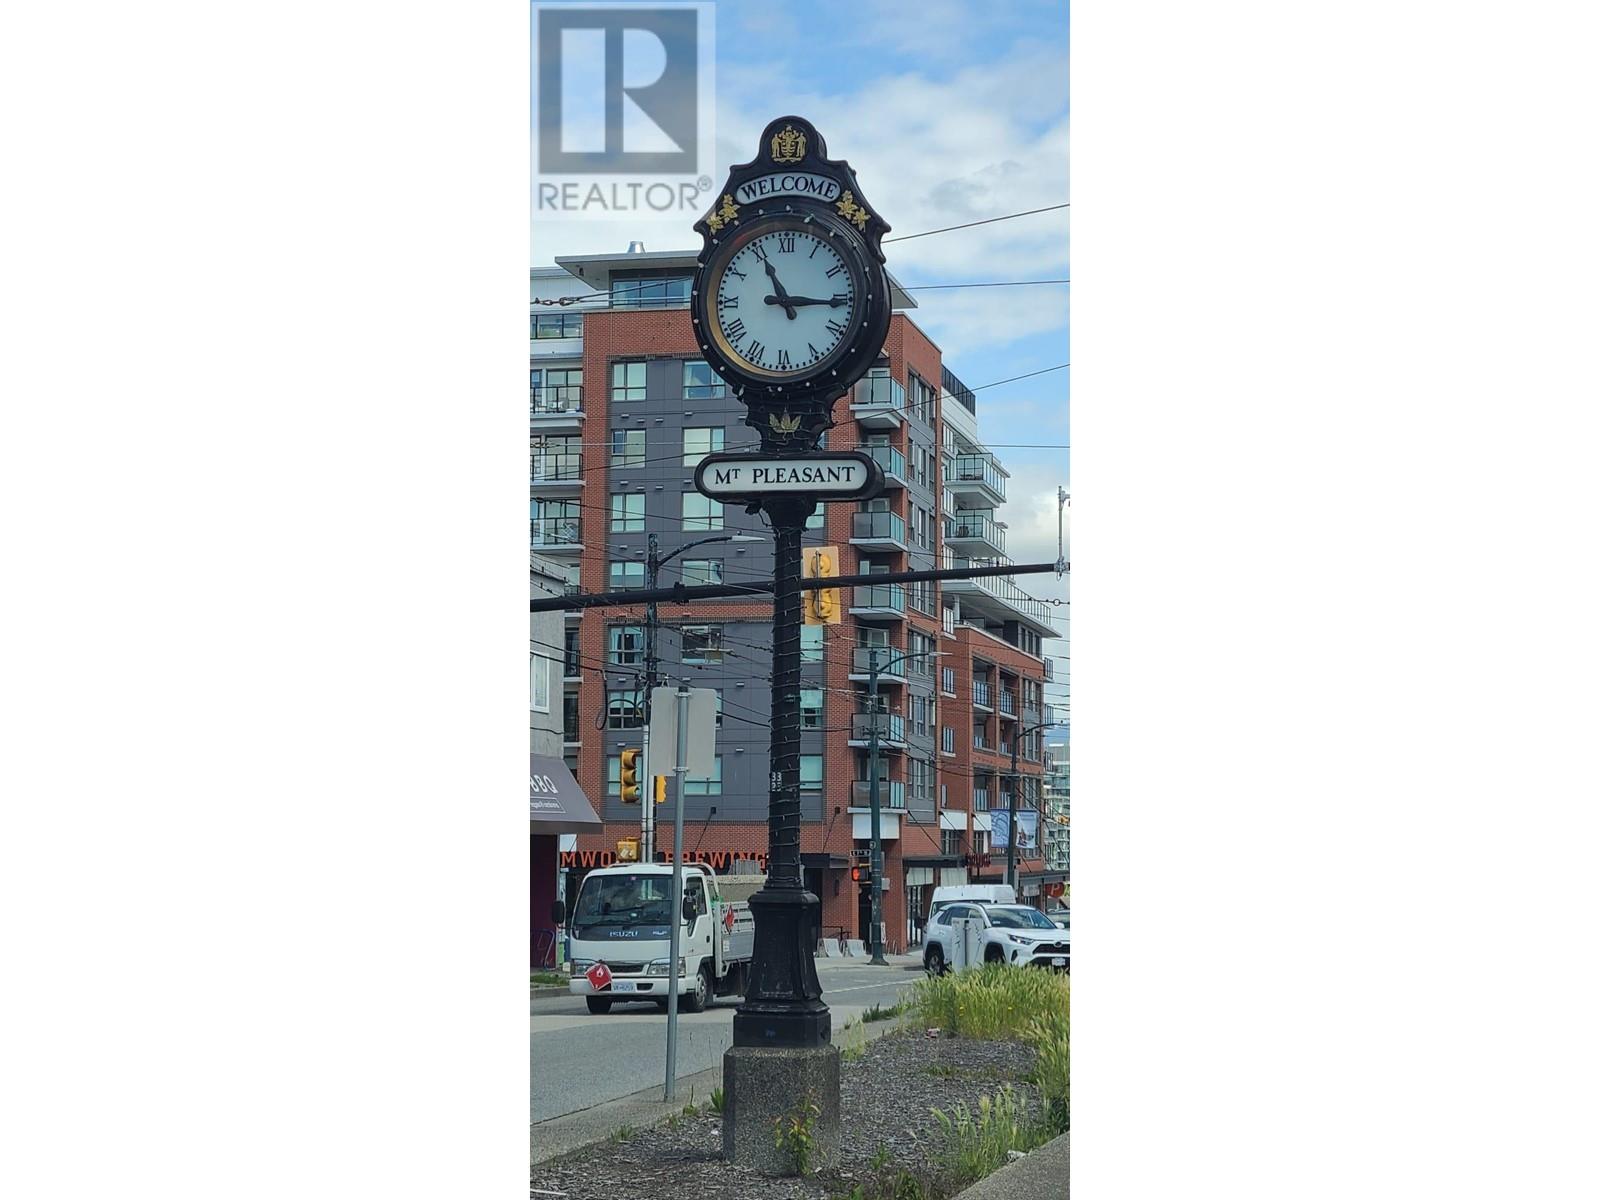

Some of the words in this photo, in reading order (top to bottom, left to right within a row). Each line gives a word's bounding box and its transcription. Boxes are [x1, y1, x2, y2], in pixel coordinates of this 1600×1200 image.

[740, 175, 838, 201] WELCOME
[778, 238, 795, 253] XII
[809, 243, 819, 259] I
[731, 268, 747, 281] X
[825, 265, 841, 279] II
[752, 466, 856, 484] PLEASANT
[609, 930, 639, 938] ISUZU
